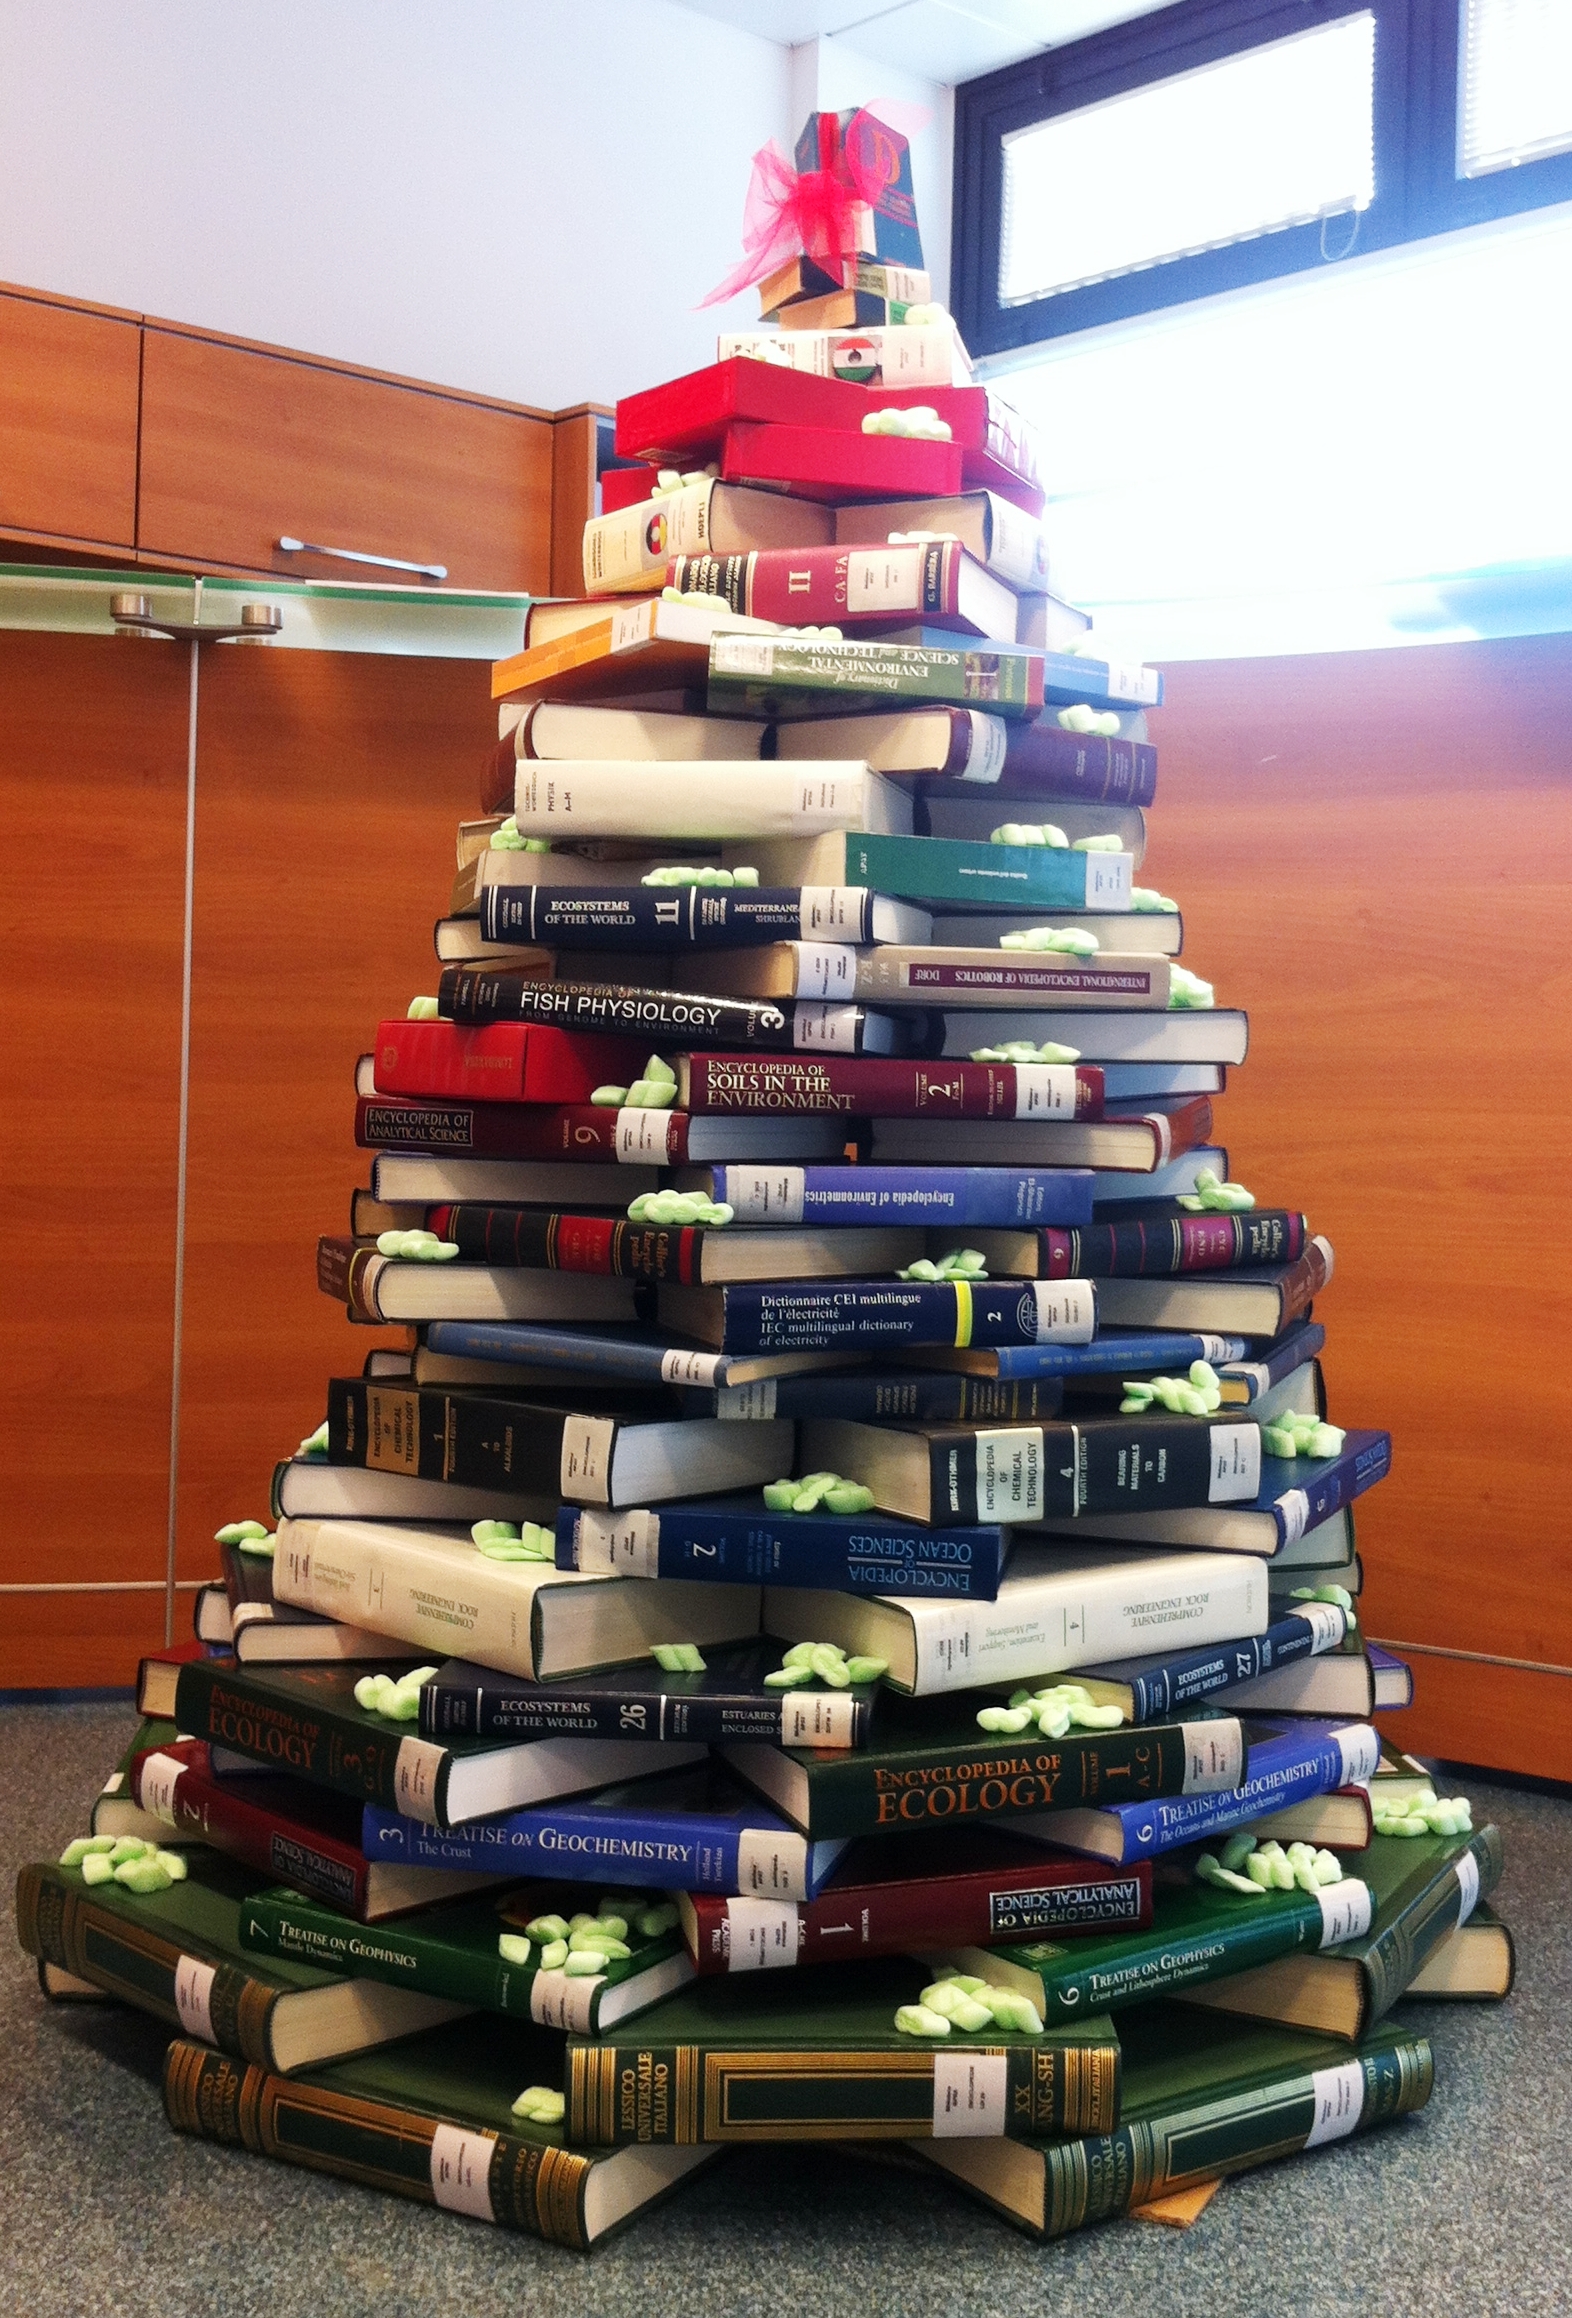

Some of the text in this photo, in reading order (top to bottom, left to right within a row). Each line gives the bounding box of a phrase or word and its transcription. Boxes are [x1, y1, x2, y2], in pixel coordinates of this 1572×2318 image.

[807, 655, 929, 678] ENVIRONMENTAL
[899, 650, 960, 667] SCIENCE
[547, 782, 556, 812] PHYSIK
[551, 900, 630, 913] ECOSYSTEMS
[544, 914, 636, 926] OF THE WORLD
[914, 969, 941, 982] DORF
[954, 970, 1003, 984] ROBOTICS
[1003, 971, 1016, 984] OF
[1018, 972, 1080, 987] ENCYCLOPEDIA
[522, 981, 613, 998] ENCYCLOPEDIA
[521, 992, 569, 1013] FISH
[577, 996, 722, 1026] PHYSIOLOGY
[519, 1009, 720, 1036] FROM GENOME TO ENVIRONMENT
[761, 1010, 785, 1030] 3
[707, 1059, 826, 1077] ENCYCLOPEDIA OF
[707, 1074, 832, 1093] SOILS IN THE
[928, 1083, 951, 1099] 2
[707, 1090, 856, 1110] ENVIRONMENT
[368, 1109, 470, 1127] ENCYCLOPEDIA OF
[368, 1125, 470, 1142] ANALYTICAL SCIENCE
[574, 1125, 600, 1143] 9
[804, 1191, 877, 1207] Environmetrics
[879, 1191, 890, 1205] of
[892, 1191, 955, 1207] Encyclopedia
[761, 1293, 922, 1308] Dictionnaire CEI multilingue
[760, 1308, 775, 1320] de
[987, 1310, 1002, 1323] 2
[760, 1318, 914, 1335] IEC multilingual dictionary
[758, 1334, 829, 1347] of electricity
[372, 1396, 381, 1458] ENCYCLOPEDIA
[393, 1406, 402, 1454] CHEMICAL
[404, 1400, 414, 1464] TECHNOLOGY
[1026, 1441, 1038, 1509] TECHNOLOGY
[1059, 1466, 1074, 1479] 4
[1130, 1443, 1141, 1490] MATERIALS
[1145, 1460, 1153, 1472] TO
[985, 1443, 995, 1511] ENCYCLOPEDIA
[1000, 1471, 1008, 1483] OF
[1011, 1450, 1022, 1502] CHEMICAL
[692, 1541, 717, 1559] 2
[848, 1535, 972, 1563] OCEAN SCIENCES
[850, 1566, 970, 1591] ENCYCLOPEDIA
[457, 1602, 479, 1618] ROCK
[1122, 1592, 1210, 1617] ROCK ENGINEERING
[1131, 1606, 1203, 1627] COMPREHENSIVE
[1178, 1659, 1225, 1686] ECOSYSTEMS
[1236, 1652, 1253, 1678] 27
[1175, 1673, 1229, 1701] OF THE WORLD
[500, 1700, 592, 1714] ECOSYSTEMS
[721, 1710, 776, 1721] ESTUARIES
[493, 1715, 598, 1729] OF THE WORLD
[620, 1704, 647, 1730] 26
[208, 1707, 317, 1770] ECOLOGY
[721, 1724, 774, 1735] ENCLOSED
[874, 1754, 1062, 1790] ENCYCLOPEDIA OF
[1105, 1762, 1131, 1779] 1
[876, 1773, 1062, 1824] ECOLOGY
[1158, 1759, 1320, 1827] TREATISE GEOCHEMISTRY
[379, 1827, 404, 1844] 3
[1136, 1825, 1153, 1843] 6
[1160, 1828, 1174, 1843] The
[418, 1841, 472, 1858] The Crust
[538, 1828, 693, 1862] GEOCHEMISTRY
[996, 1882, 1136, 1911] ANALYTICAL SCIENCE
[1023, 1900, 1136, 1926] ENCYCLOPEDIA
[249, 1919, 268, 1938] 7
[819, 1922, 854, 1935] 1
[860, 1908, 869, 1943] VOLUME
[279, 1920, 417, 1969] TREATISE ON GEOPHYSICS
[1089, 1943, 1226, 1991] TREATISE ON GEOPHYSICS
[1058, 1986, 1080, 2006] 6
[1089, 1989, 1111, 2002] Crust
[1111, 1985, 1128, 1998] and
[1128, 1972, 1172, 1996] Lithosphere
[621, 2068, 636, 2131] LESSICO
[637, 2051, 652, 2143] UNIVERSALE
[653, 2063, 669, 2135] ITALIANO
[1015, 2084, 1031, 2114] XX
